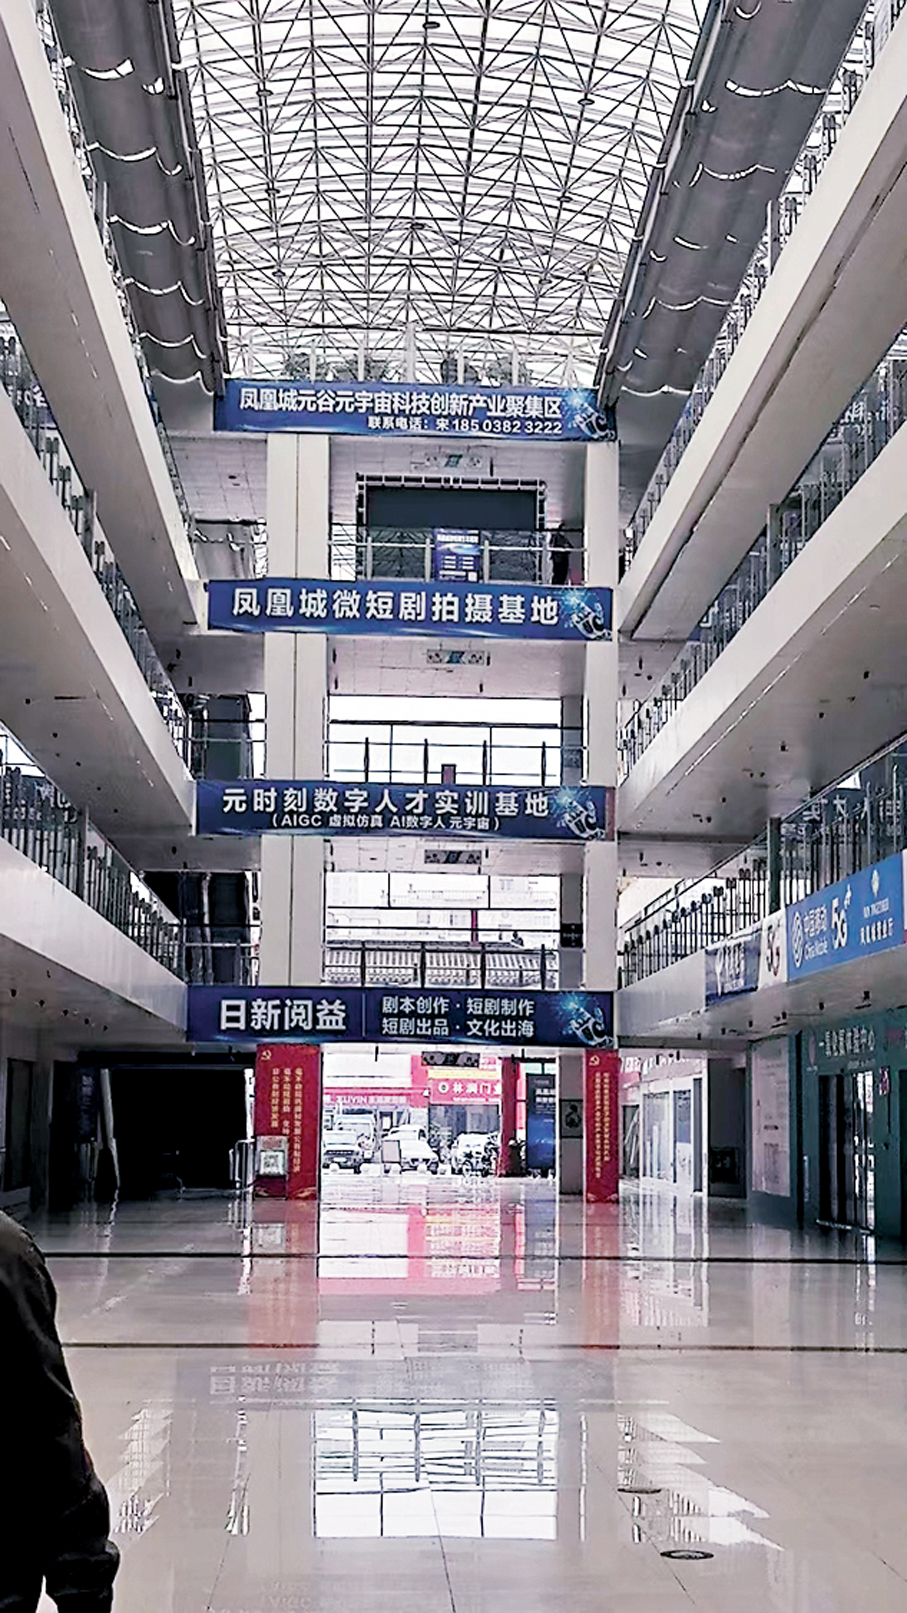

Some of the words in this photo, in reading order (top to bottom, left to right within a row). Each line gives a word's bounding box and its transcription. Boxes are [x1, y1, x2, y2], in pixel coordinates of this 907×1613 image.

[239, 388, 563, 418] 凤凰城元谷元宇宙科技创新产业聚集区
[452, 419, 479, 431] 185
[482, 420, 521, 433] 0382
[524, 421, 562, 434] 3222
[232, 588, 560, 625] 凤凰城微短剧拍摄基地
[223, 788, 549, 817] 元时刻数字人才实训基地
[329, 815, 383, 828] 虚拟仿真
[220, 999, 346, 1030] 日新阅益
